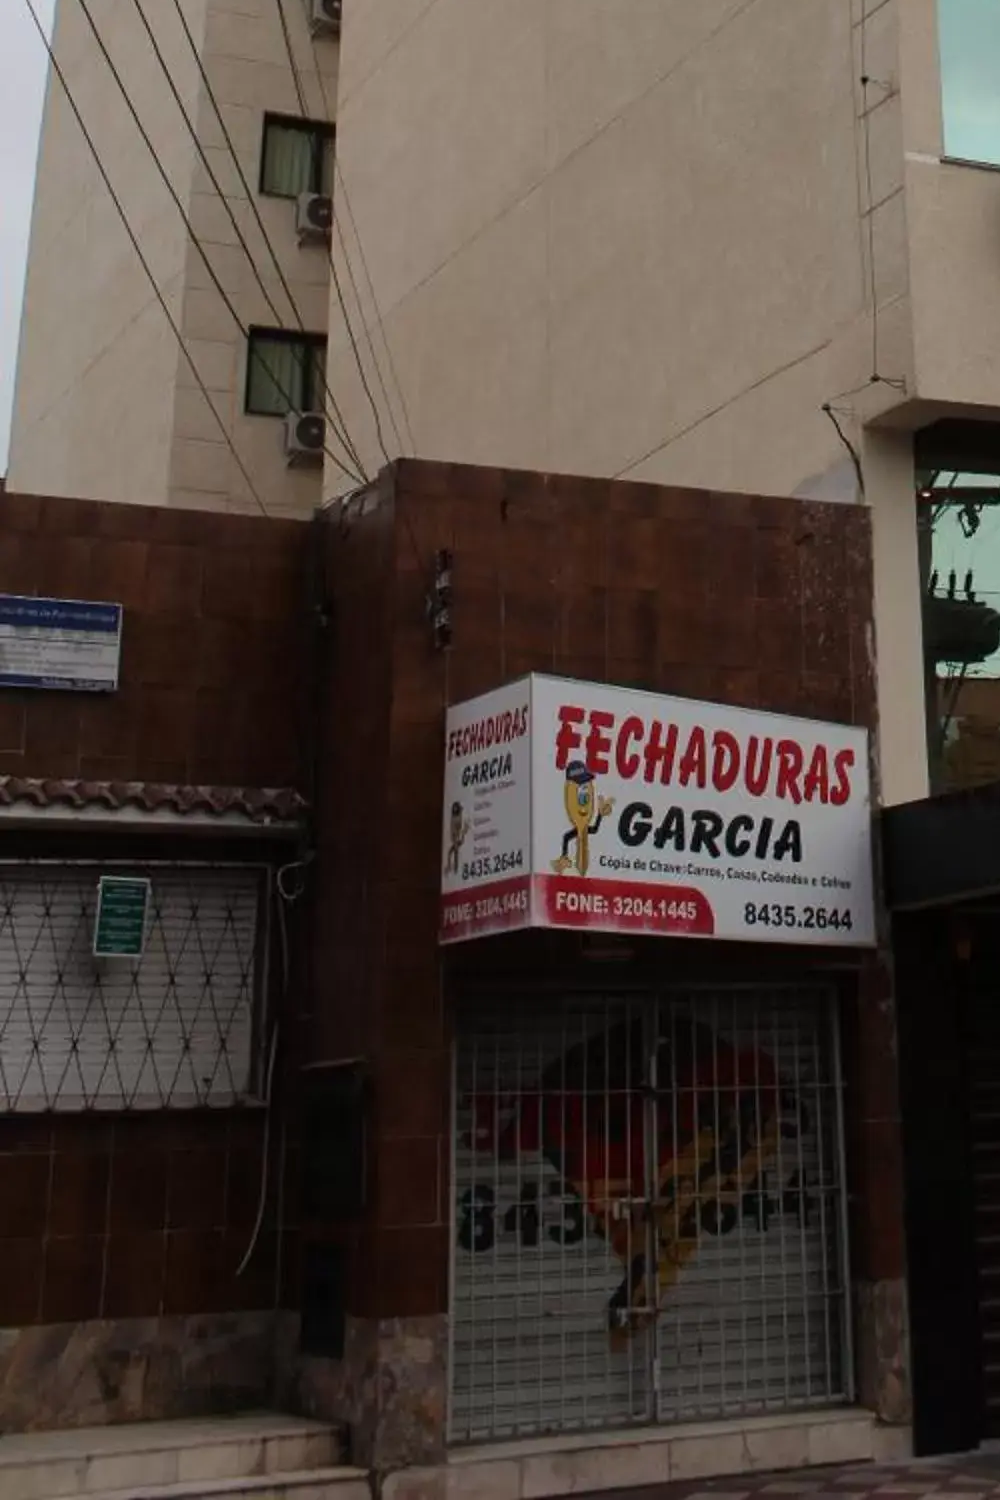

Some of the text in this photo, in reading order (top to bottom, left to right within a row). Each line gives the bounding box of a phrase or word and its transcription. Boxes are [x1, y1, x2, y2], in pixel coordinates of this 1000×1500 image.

[447, 704, 529, 762] FECHADURAS
[461, 753, 513, 788] GARCIA
[555, 705, 855, 806] FECHADURAS
[617, 801, 803, 863] GARCIA
[462, 847, 523, 881] 8435.2644
[633, 858, 647, 871] de
[555, 891, 697, 920] FONE: 3204.1445
[744, 903, 853, 931] 8435.2644
